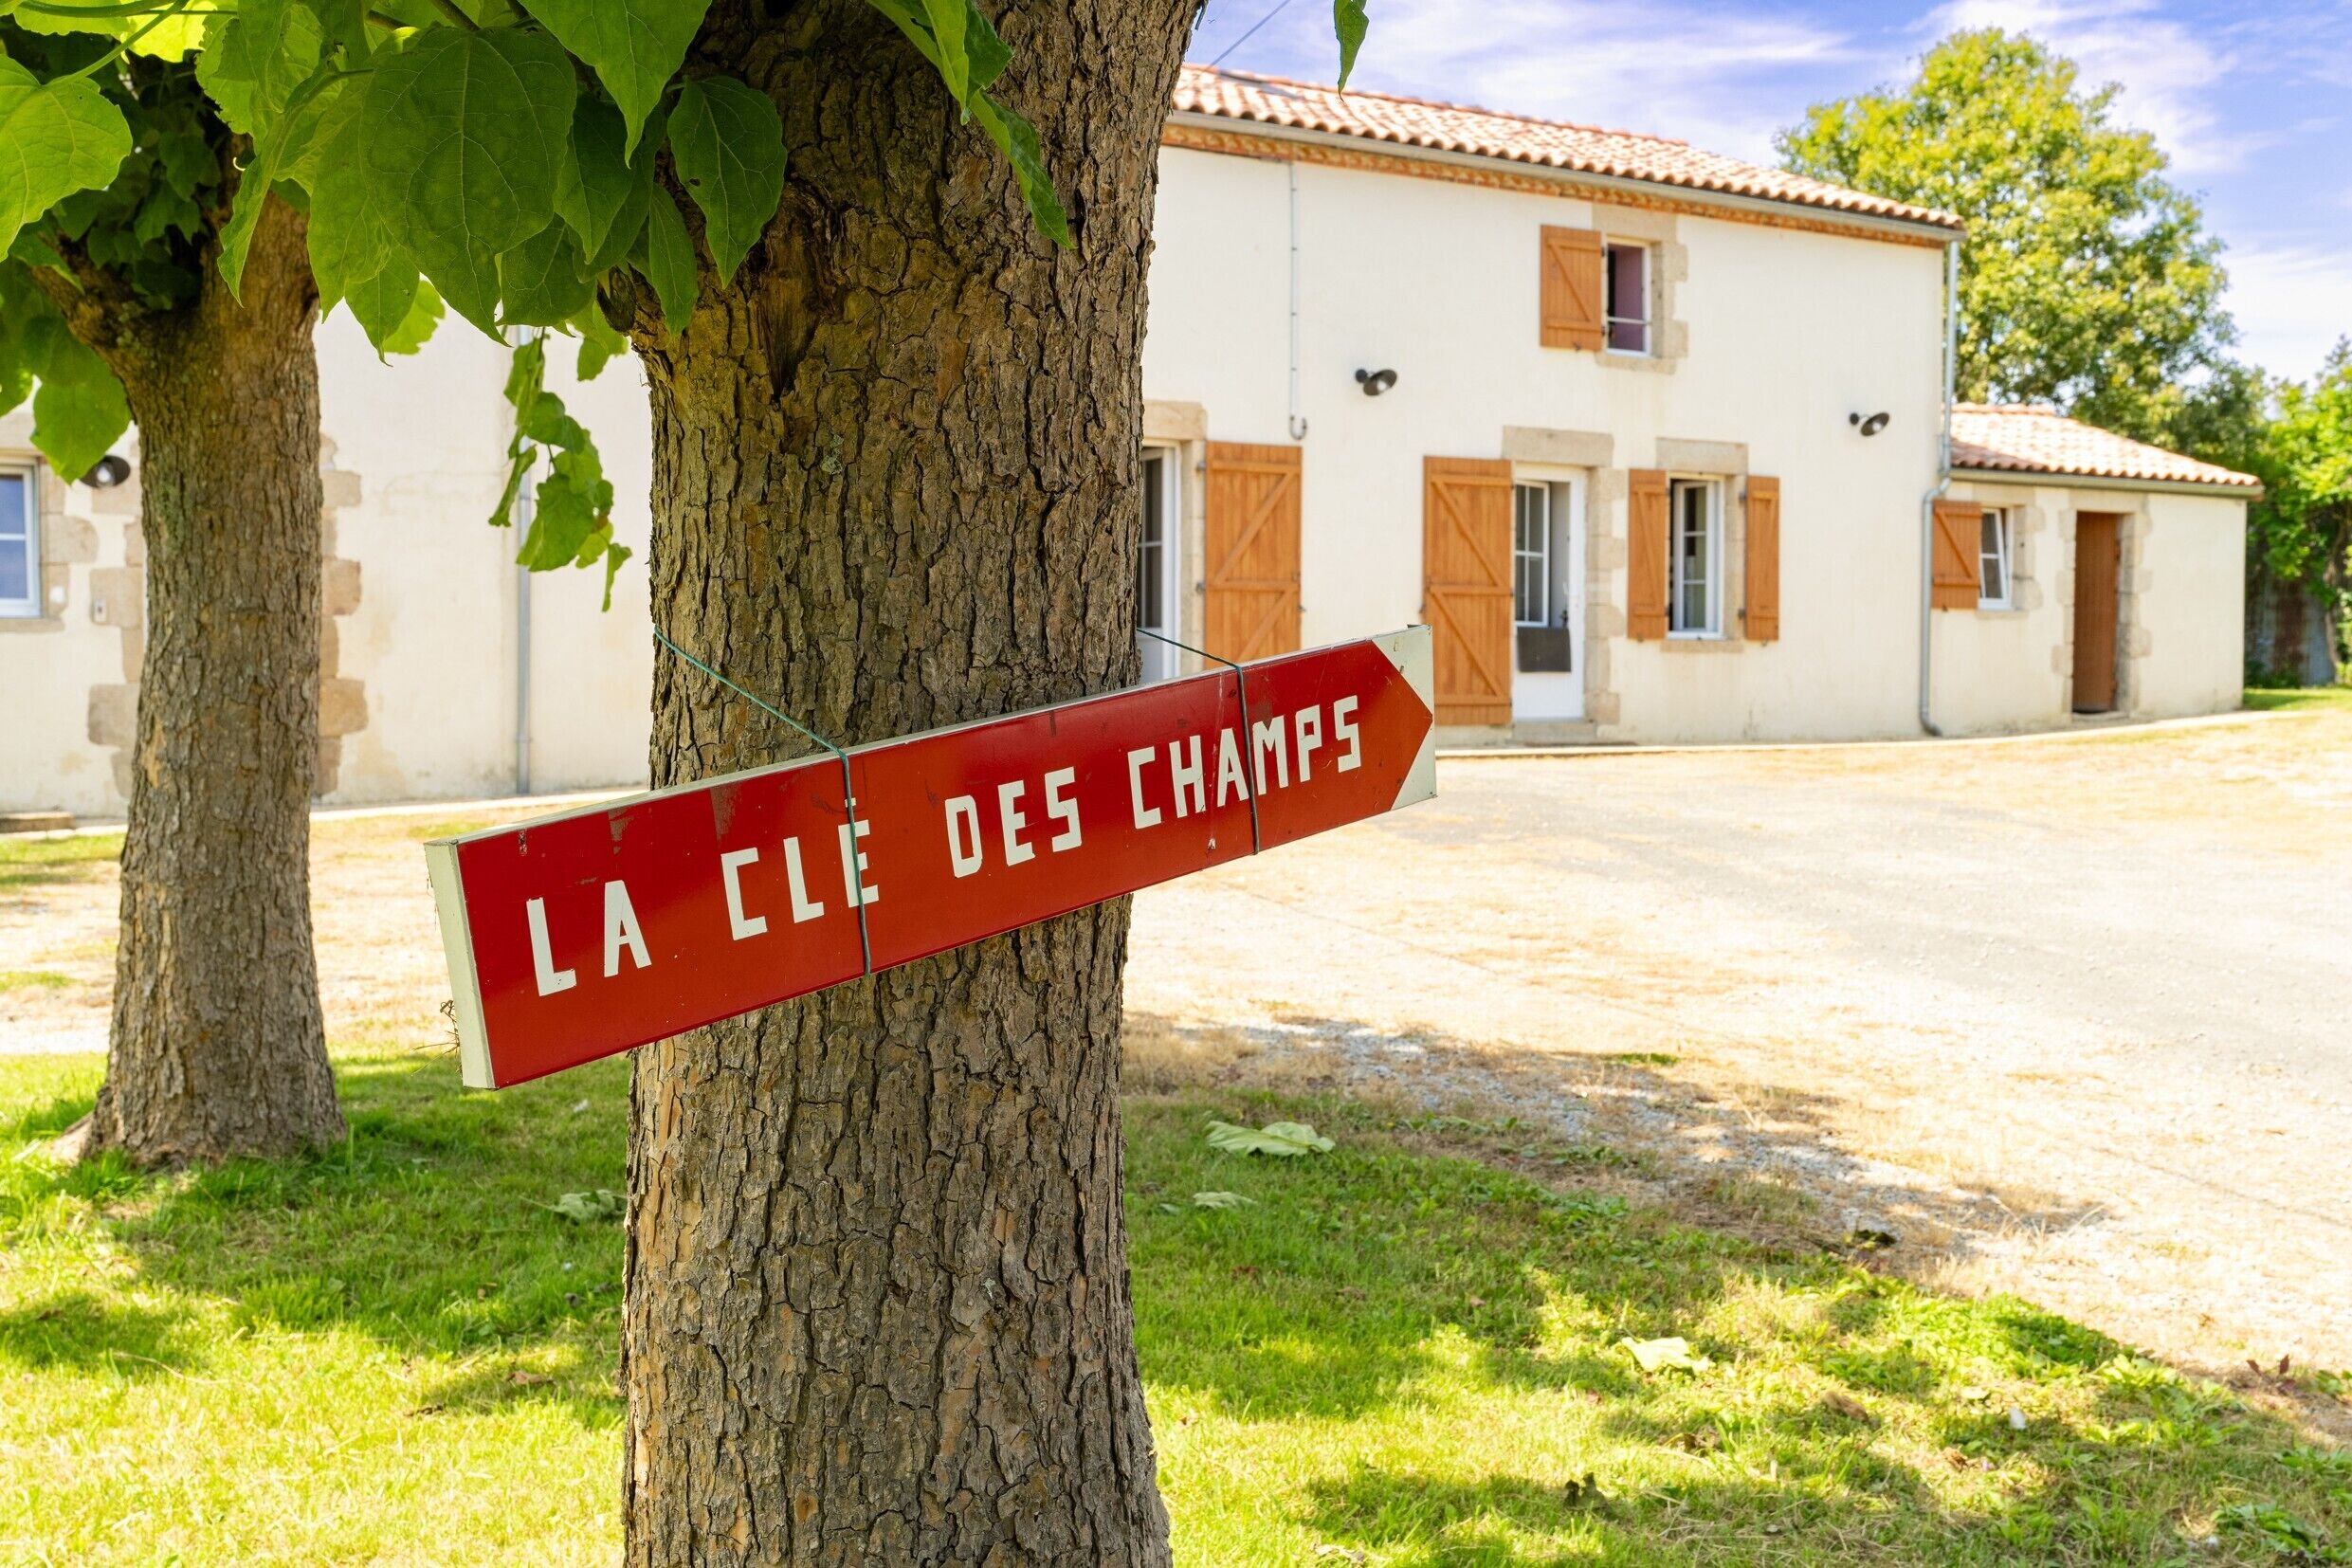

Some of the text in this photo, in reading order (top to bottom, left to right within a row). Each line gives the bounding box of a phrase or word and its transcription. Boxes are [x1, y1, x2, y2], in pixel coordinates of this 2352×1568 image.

[526, 880, 652, 996] LA
[944, 766, 1083, 879] DES
[1127, 695, 1361, 830] CHAMPS
